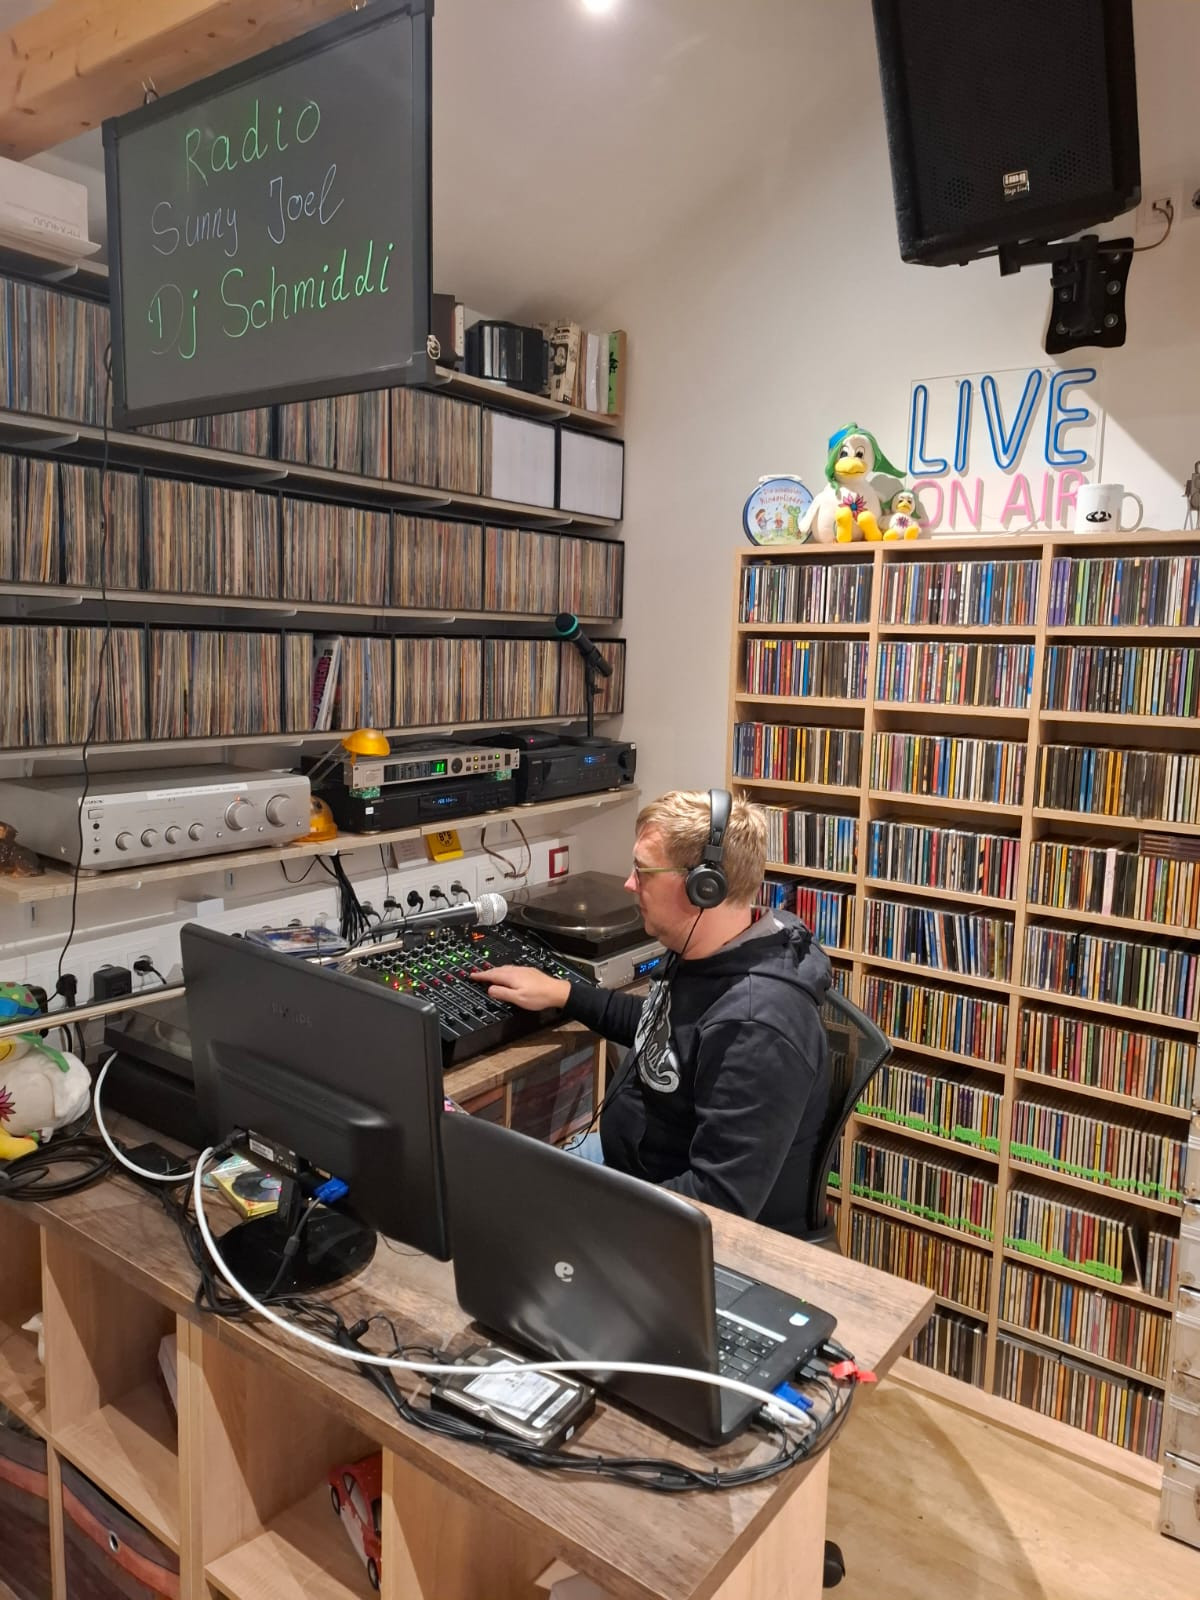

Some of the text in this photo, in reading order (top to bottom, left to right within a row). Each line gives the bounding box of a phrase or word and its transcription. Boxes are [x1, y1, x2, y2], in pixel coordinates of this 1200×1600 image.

[185, 99, 321, 193] Radio
[151, 164, 344, 257] Sunny Joel
[148, 240, 395, 359] Dj Schmiddi
[909, 367, 1097, 476] LIVE
[911, 469, 1085, 528] ON AIR
